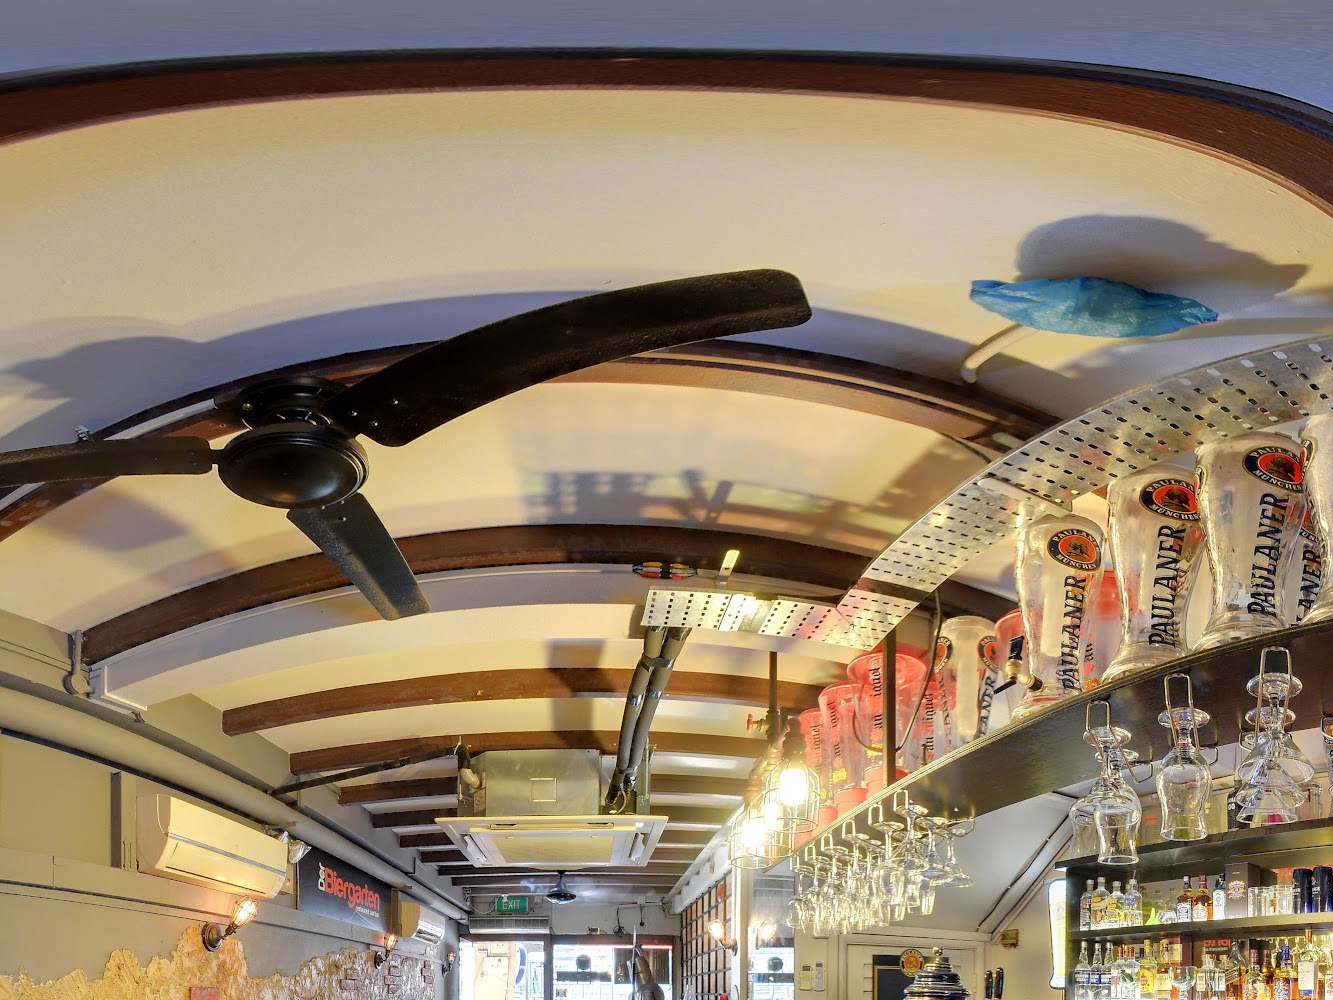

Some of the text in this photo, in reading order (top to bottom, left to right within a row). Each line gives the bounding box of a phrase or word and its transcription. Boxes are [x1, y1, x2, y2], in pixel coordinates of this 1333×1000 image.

[1250, 446, 1300, 463] PAULAN
[1145, 479, 1195, 493] PAULAN
[1247, 492, 1290, 618] PAULANER
[1149, 524, 1187, 648] PAULANER
[1057, 575, 1087, 692] PAULANER
[325, 867, 380, 910] Biergarten
[502, 899, 521, 910] EXIT
